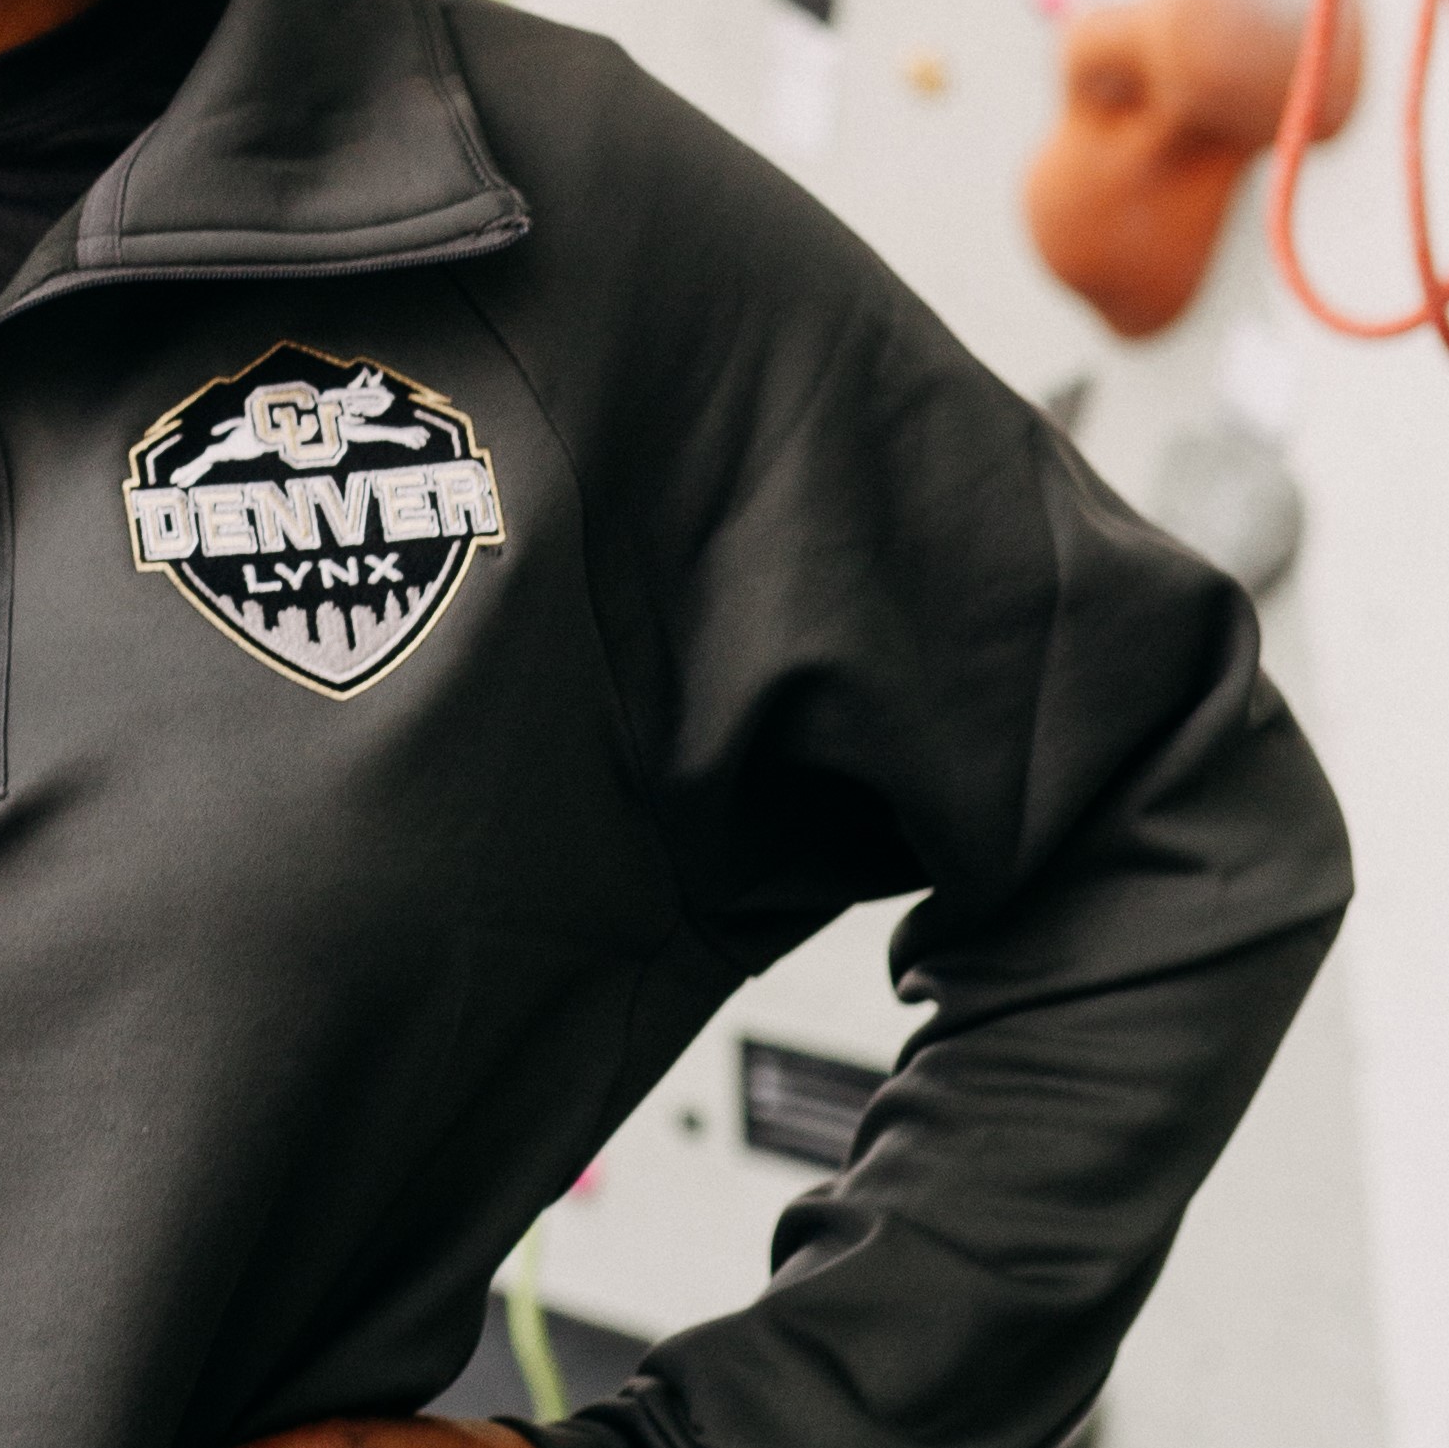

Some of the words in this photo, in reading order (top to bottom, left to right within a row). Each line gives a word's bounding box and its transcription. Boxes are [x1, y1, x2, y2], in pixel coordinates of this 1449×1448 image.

[245, 382, 348, 468] CU
[132, 460, 498, 560] DENVER
[243, 554, 403, 593] LYNX
